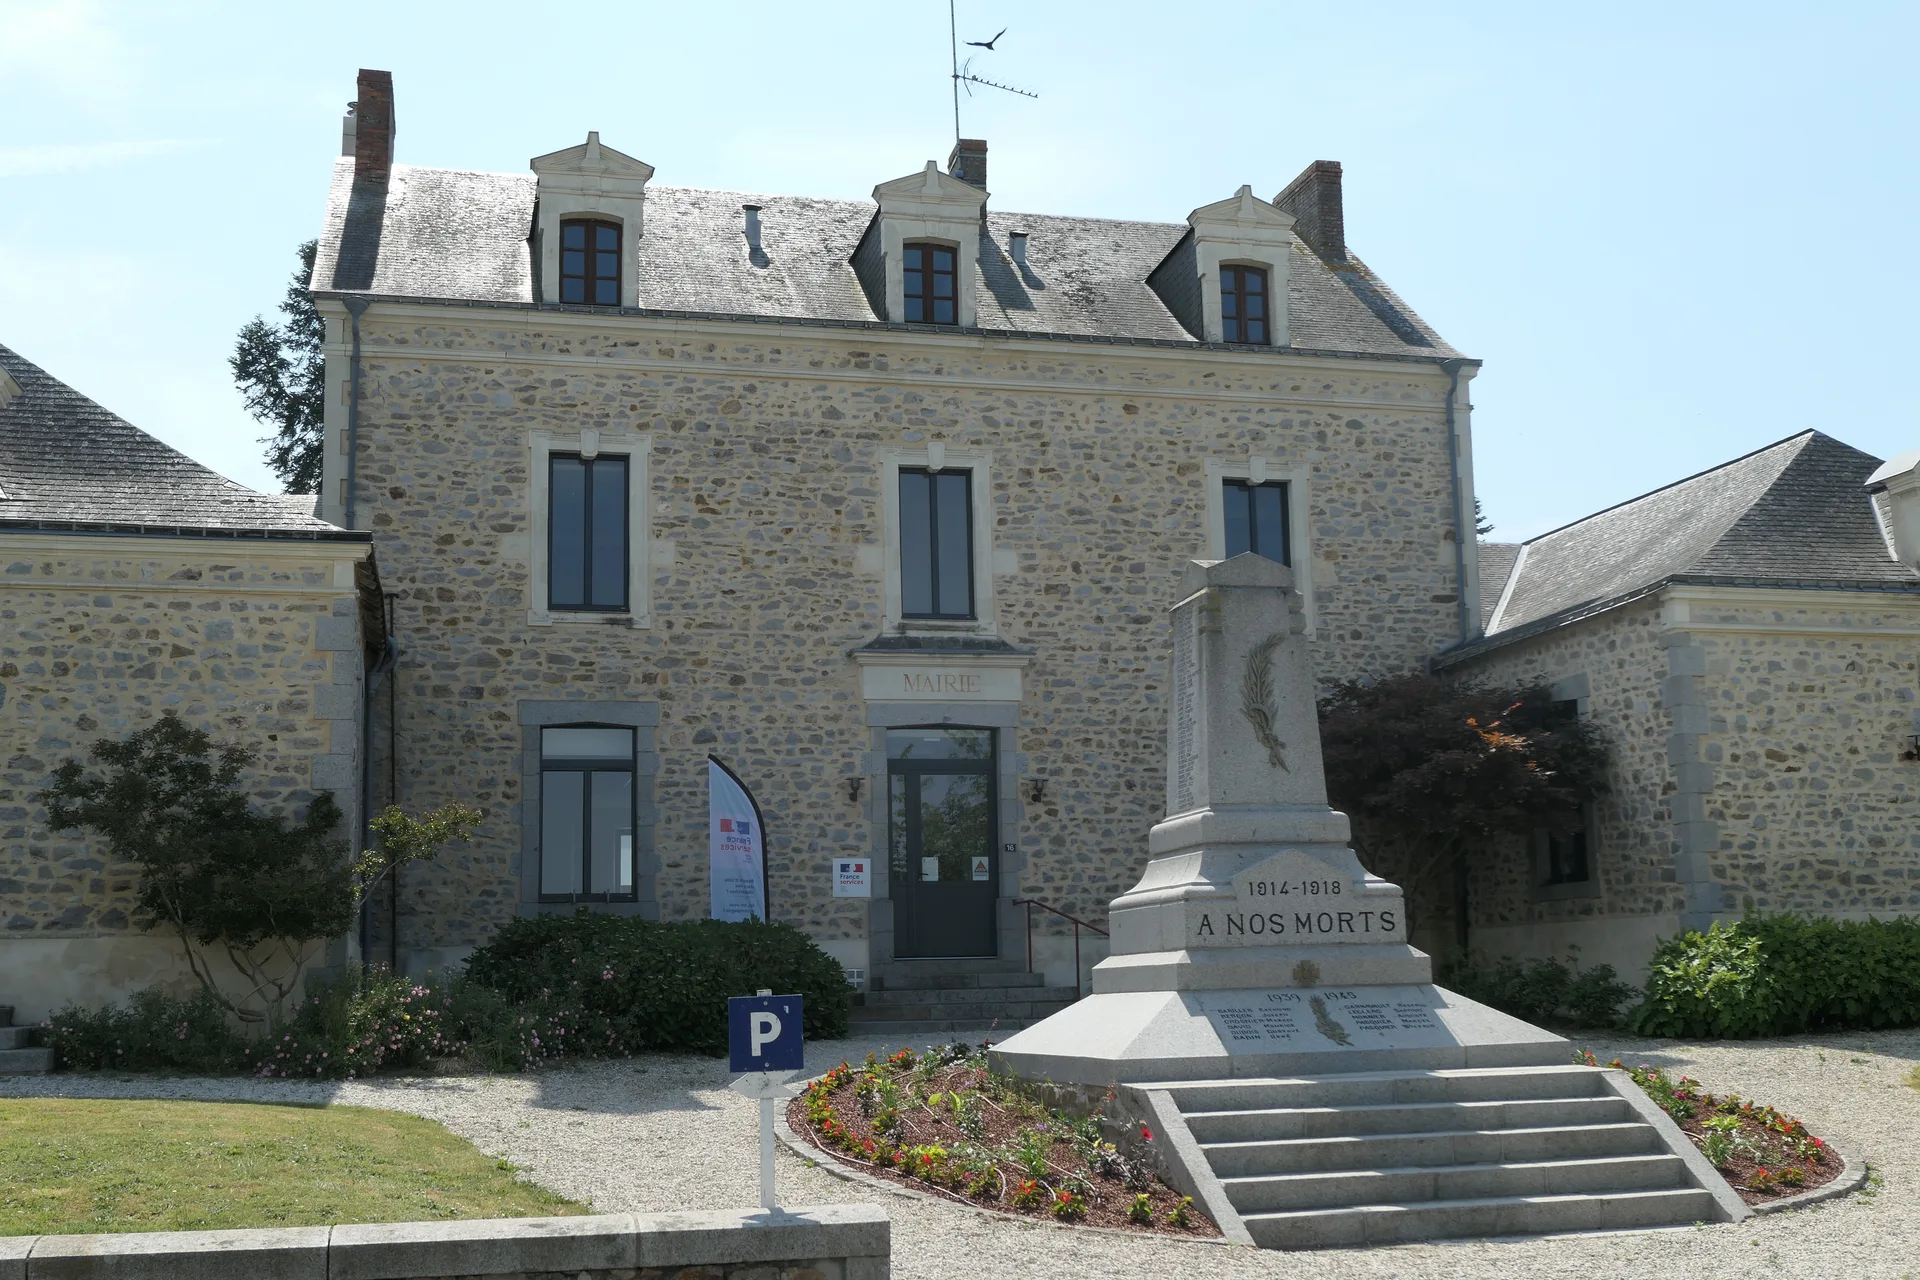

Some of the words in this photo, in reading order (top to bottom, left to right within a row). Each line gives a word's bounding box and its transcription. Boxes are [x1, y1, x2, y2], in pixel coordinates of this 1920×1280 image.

[903, 673, 980, 692] MAIRIE
[1249, 881, 1341, 896] 1914-1918
[1197, 914, 1215, 935] A
[1226, 913, 1285, 935] NOS
[1294, 911, 1396, 933] MORTS
[1267, 993, 1301, 1003] 1939
[1324, 991, 1357, 1000] 1945
[750, 1012, 782, 1057] P
